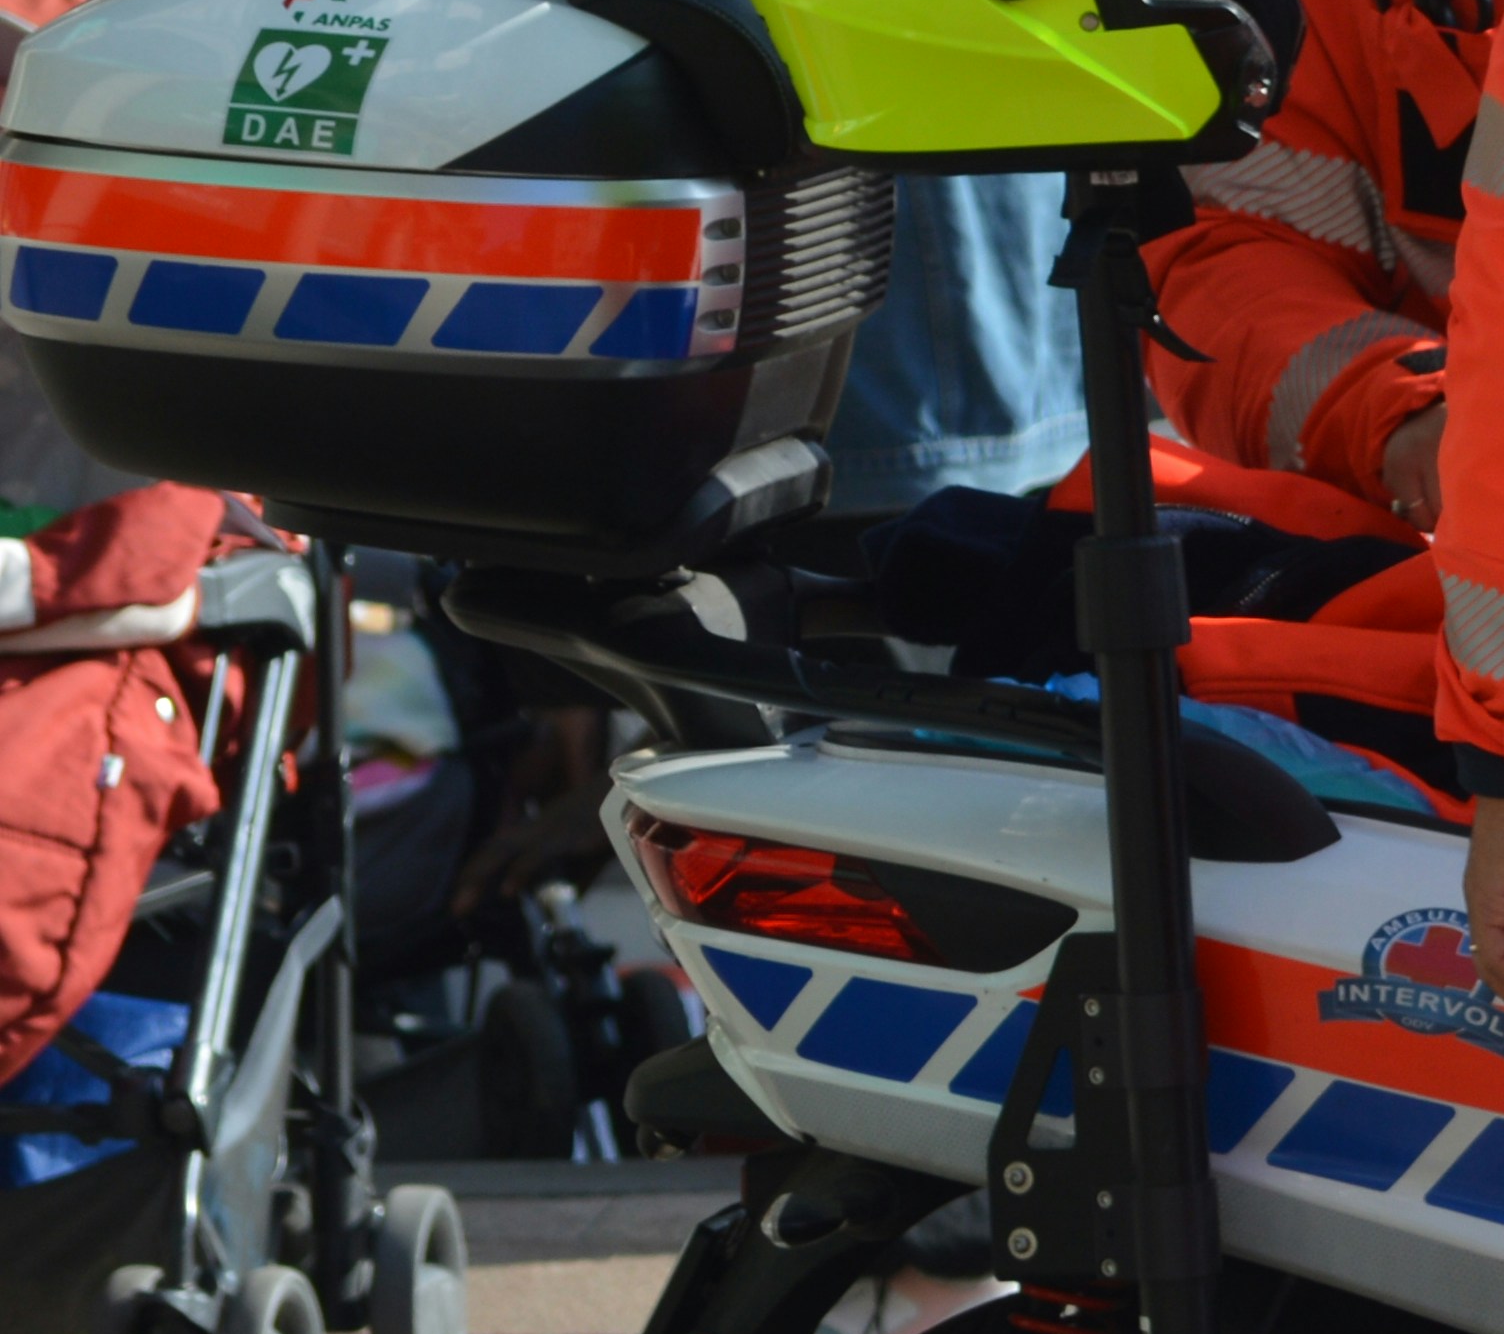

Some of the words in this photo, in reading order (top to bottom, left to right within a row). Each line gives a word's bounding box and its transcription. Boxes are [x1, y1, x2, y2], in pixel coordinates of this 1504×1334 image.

[311, 13, 391, 32] ANPAS
[240, 113, 336, 149] DAE
[1370, 910, 1470, 951] AMBUL
[1337, 984, 1504, 1037] INTERVOL
